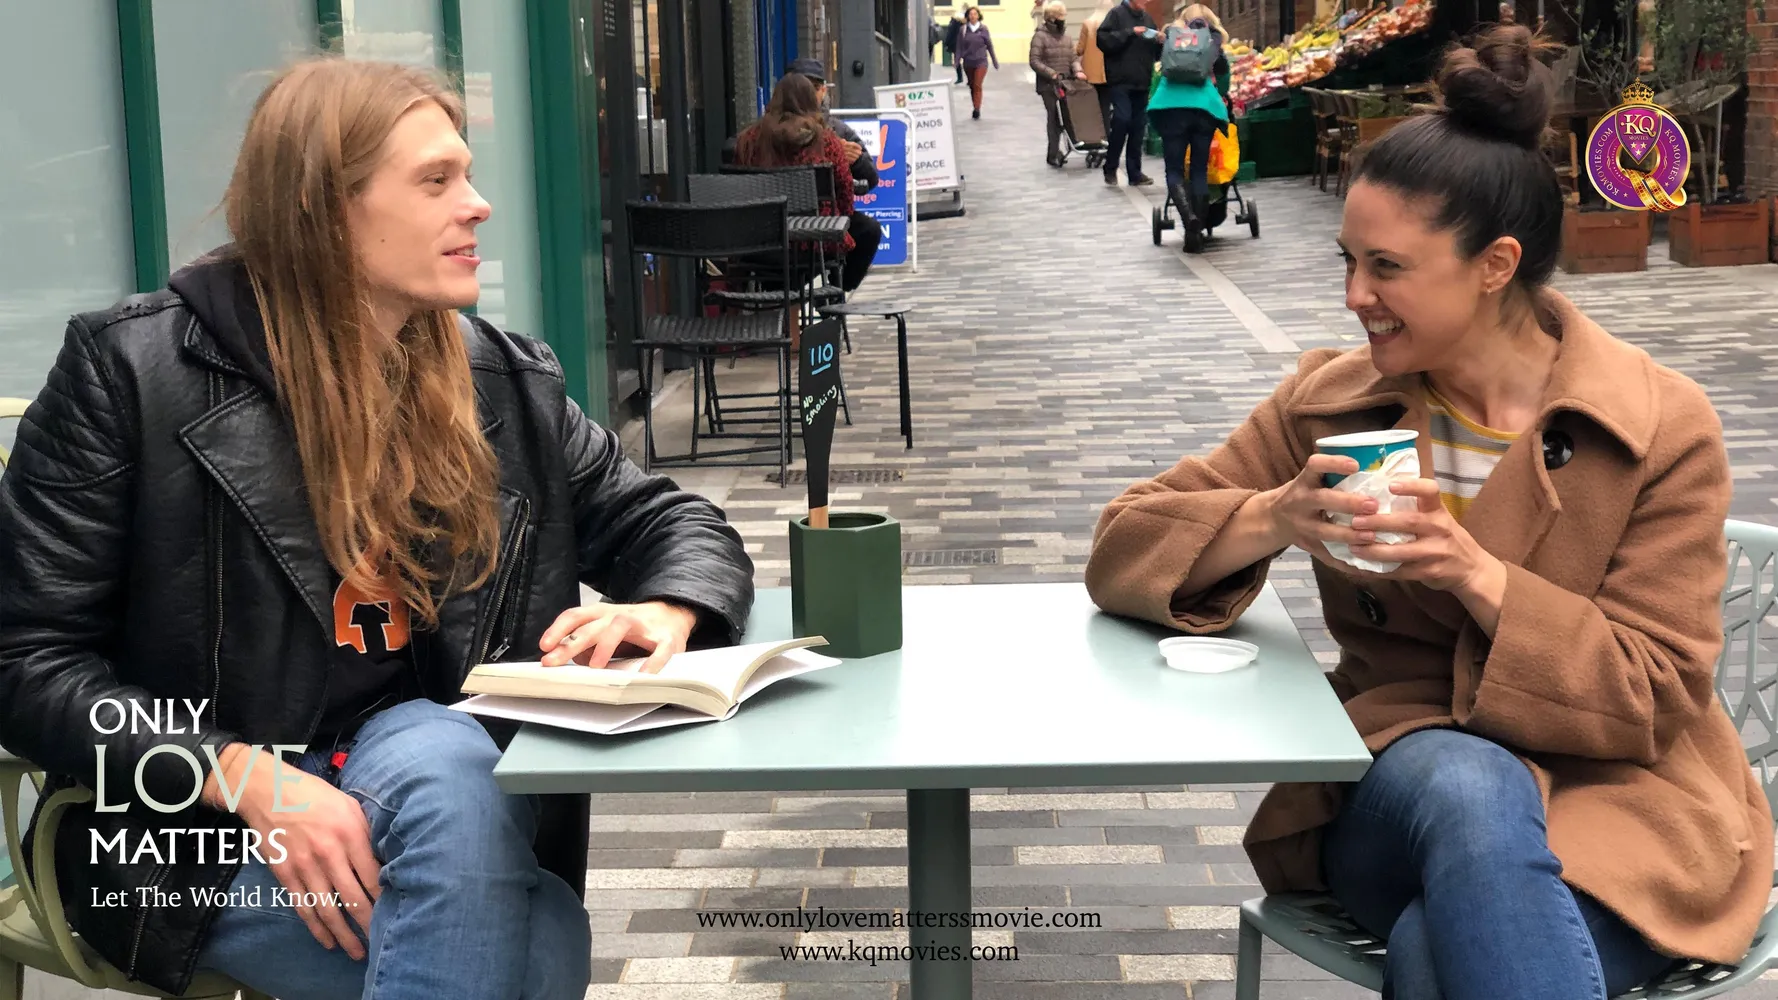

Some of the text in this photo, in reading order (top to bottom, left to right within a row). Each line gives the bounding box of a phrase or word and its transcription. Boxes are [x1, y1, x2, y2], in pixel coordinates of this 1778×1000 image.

[916, 140, 937, 150] ACE
[877, 178, 896, 188] ber
[875, 211, 902, 219] Piercing
[878, 242, 890, 250] un
[811, 343, 834, 367] 110
